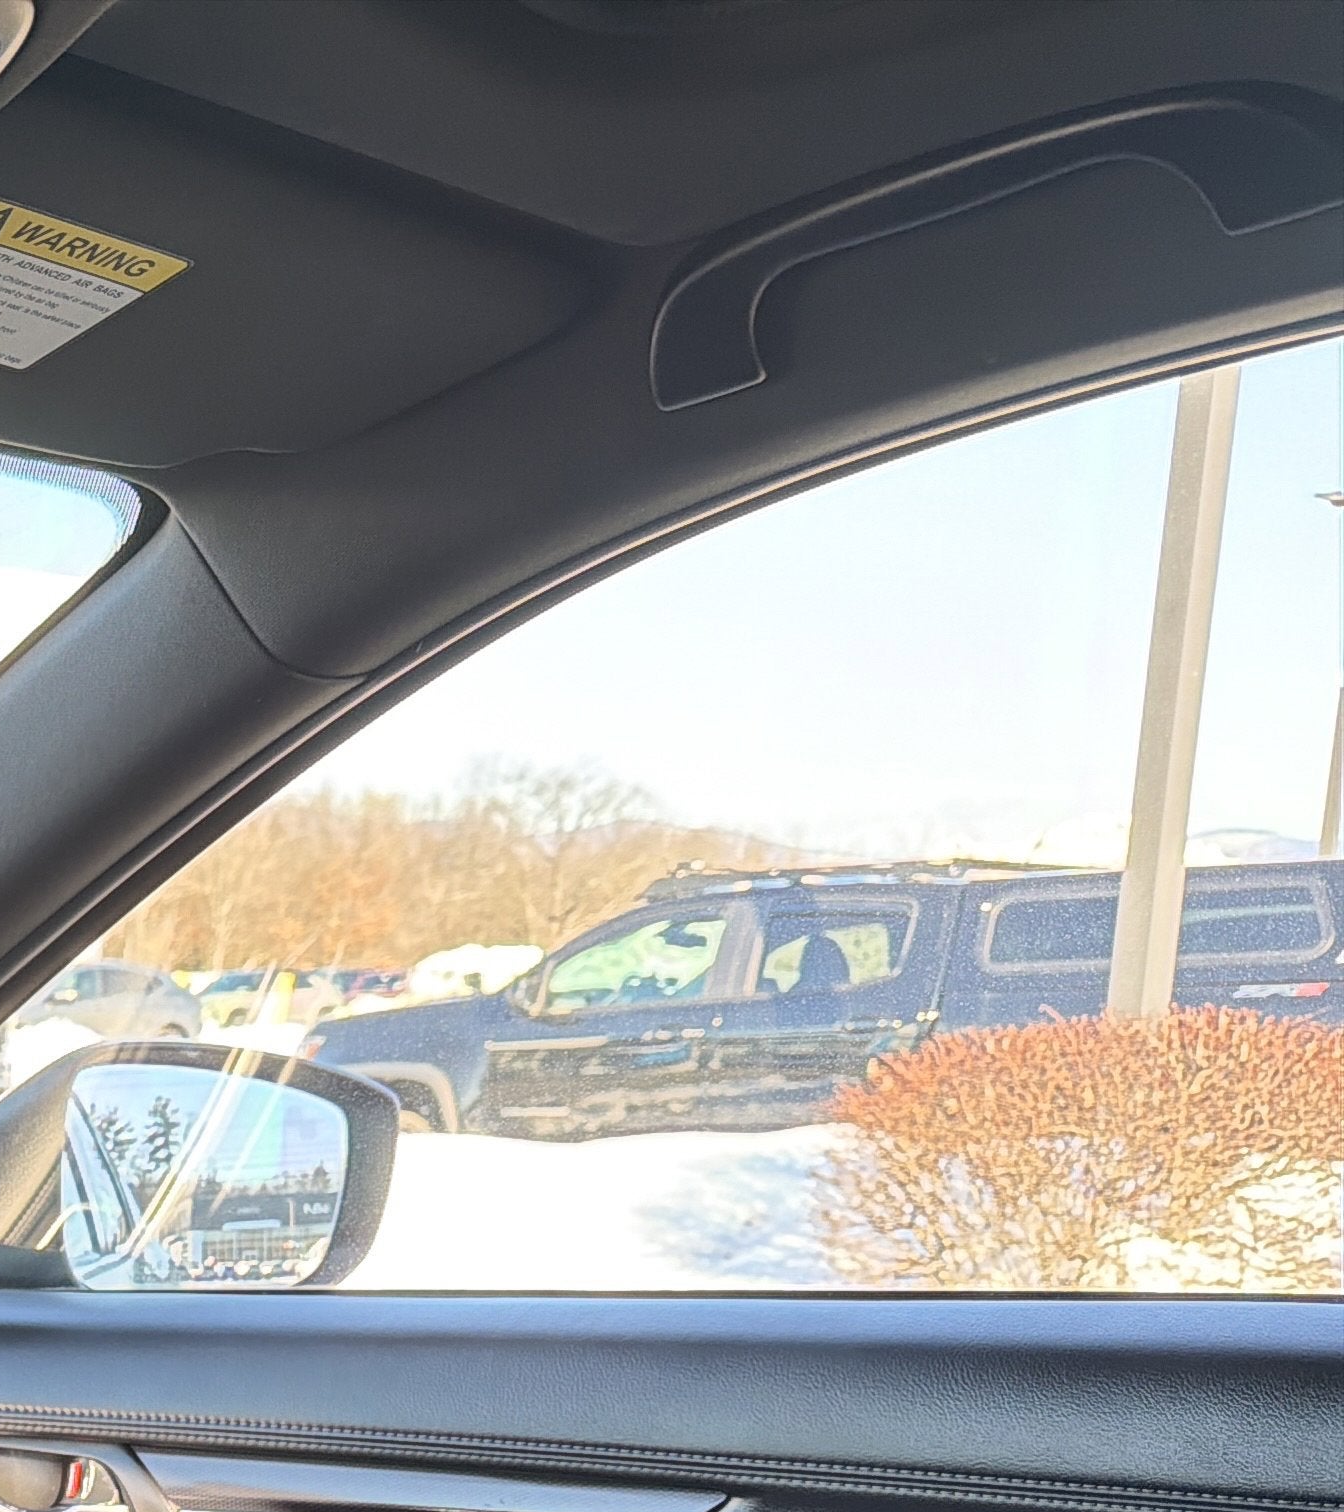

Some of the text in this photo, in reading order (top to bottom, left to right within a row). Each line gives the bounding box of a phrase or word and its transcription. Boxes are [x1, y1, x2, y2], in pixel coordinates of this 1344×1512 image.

[12, 222, 154, 276] WARNING
[13, 260, 71, 281] ADVANCED
[71, 278, 92, 288] AIR
[92, 284, 123, 298] BAGS
